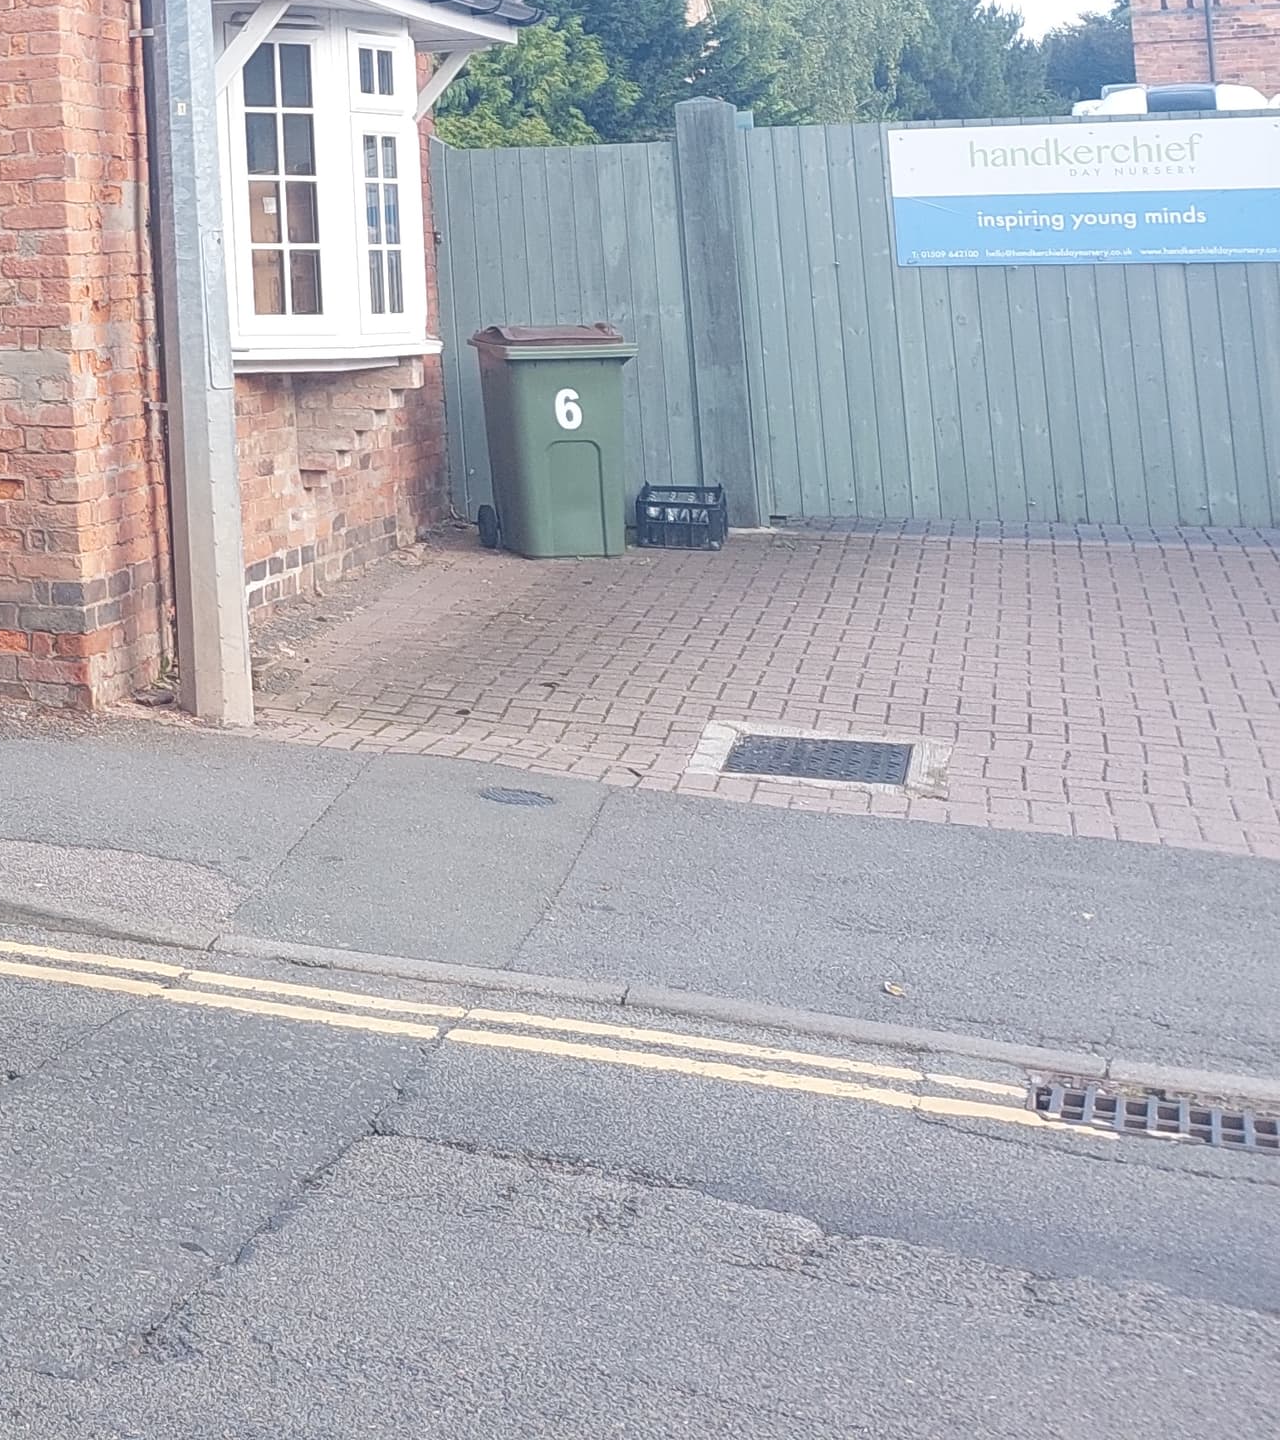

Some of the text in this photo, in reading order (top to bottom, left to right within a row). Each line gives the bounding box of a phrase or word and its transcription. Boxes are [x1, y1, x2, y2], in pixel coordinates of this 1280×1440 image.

[968, 133, 1203, 168] handkerchief
[1069, 165, 1196, 177] DAY NURSERY
[977, 205, 1208, 232] inspiring young minds
[921, 249, 945, 258] 01509
[948, 249, 979, 258] 642100
[554, 388, 583, 430] 6
